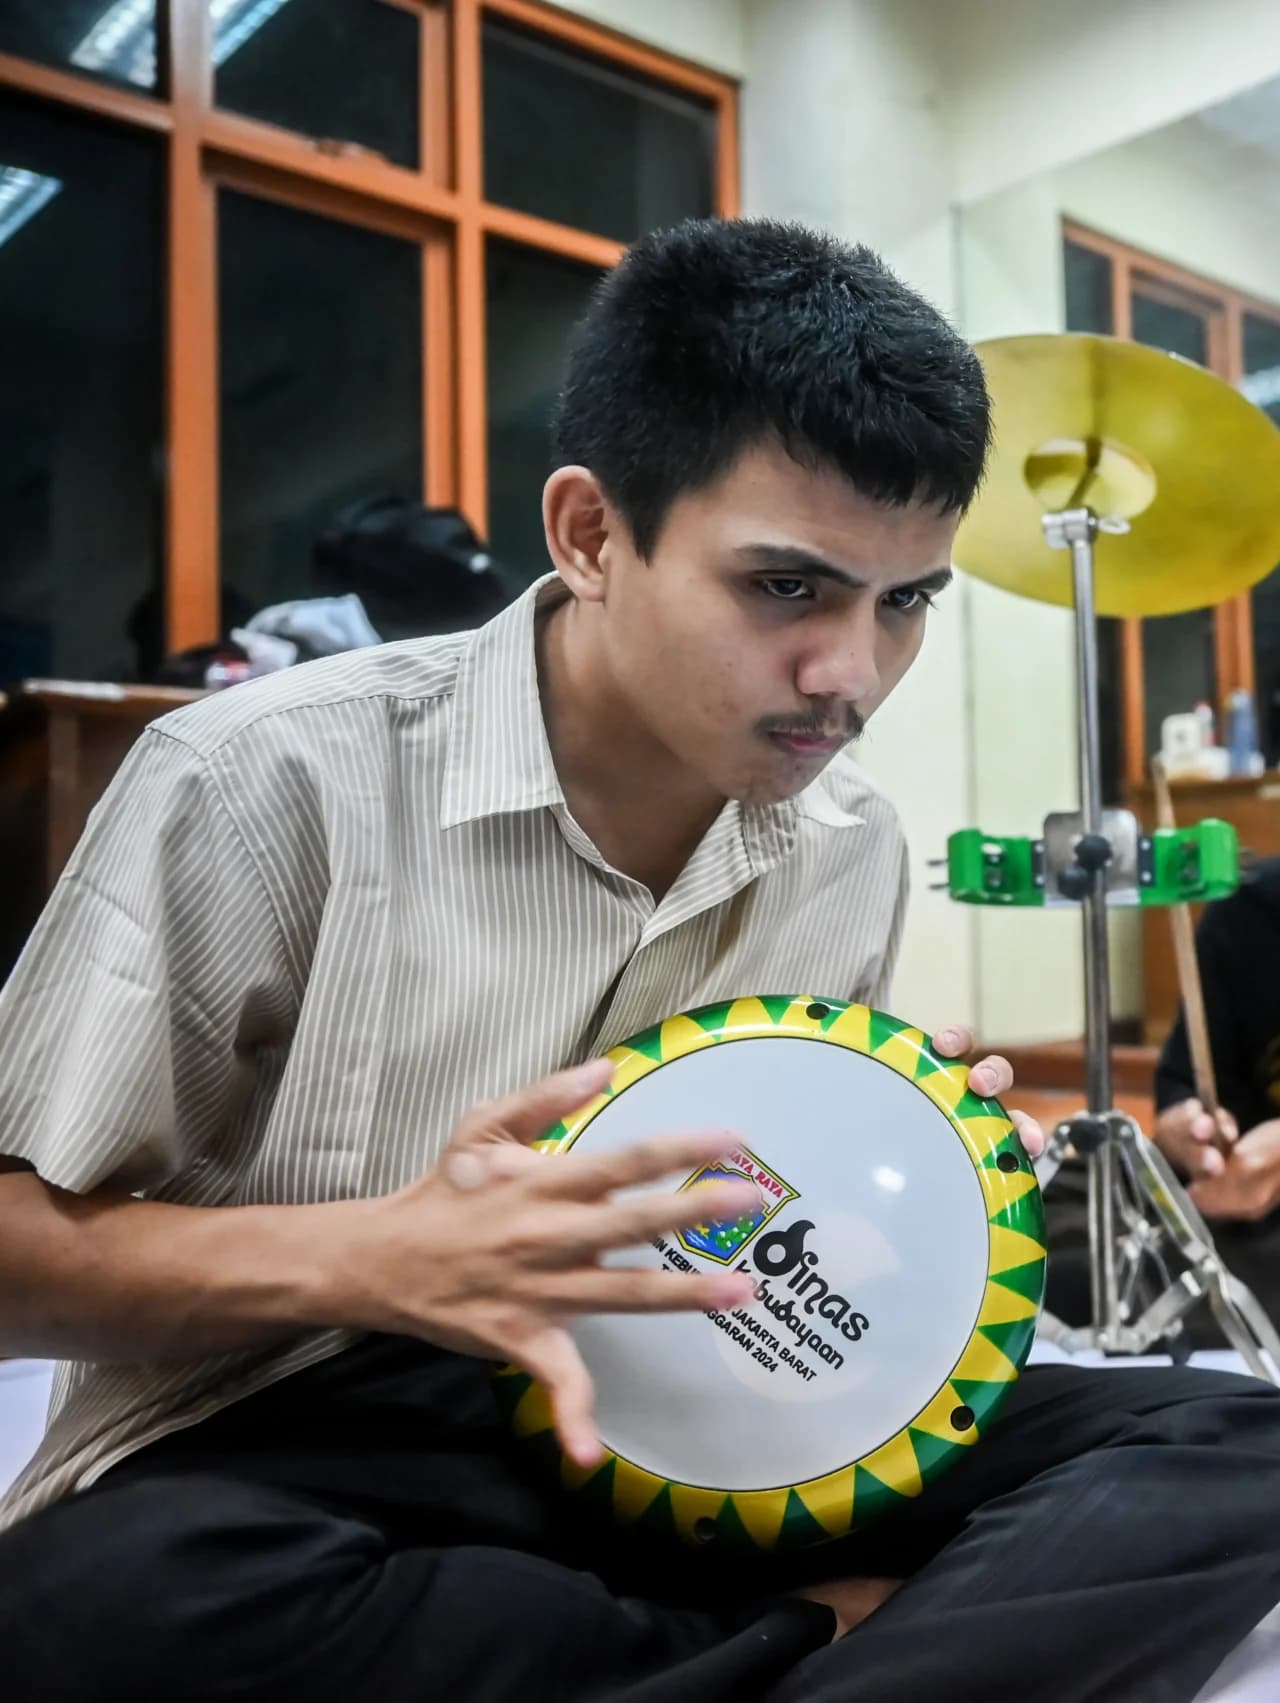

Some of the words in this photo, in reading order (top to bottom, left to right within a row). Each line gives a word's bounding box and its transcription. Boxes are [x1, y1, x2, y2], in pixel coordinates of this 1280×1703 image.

[755, 1170, 784, 1198] RAYA
[703, 1307, 756, 1352] GGARAN
[751, 1347, 779, 1373] 2024
[731, 1308, 781, 1353] JAKARTA
[778, 1347, 818, 1382] BARAT
[733, 1259, 844, 1370] budayaan
